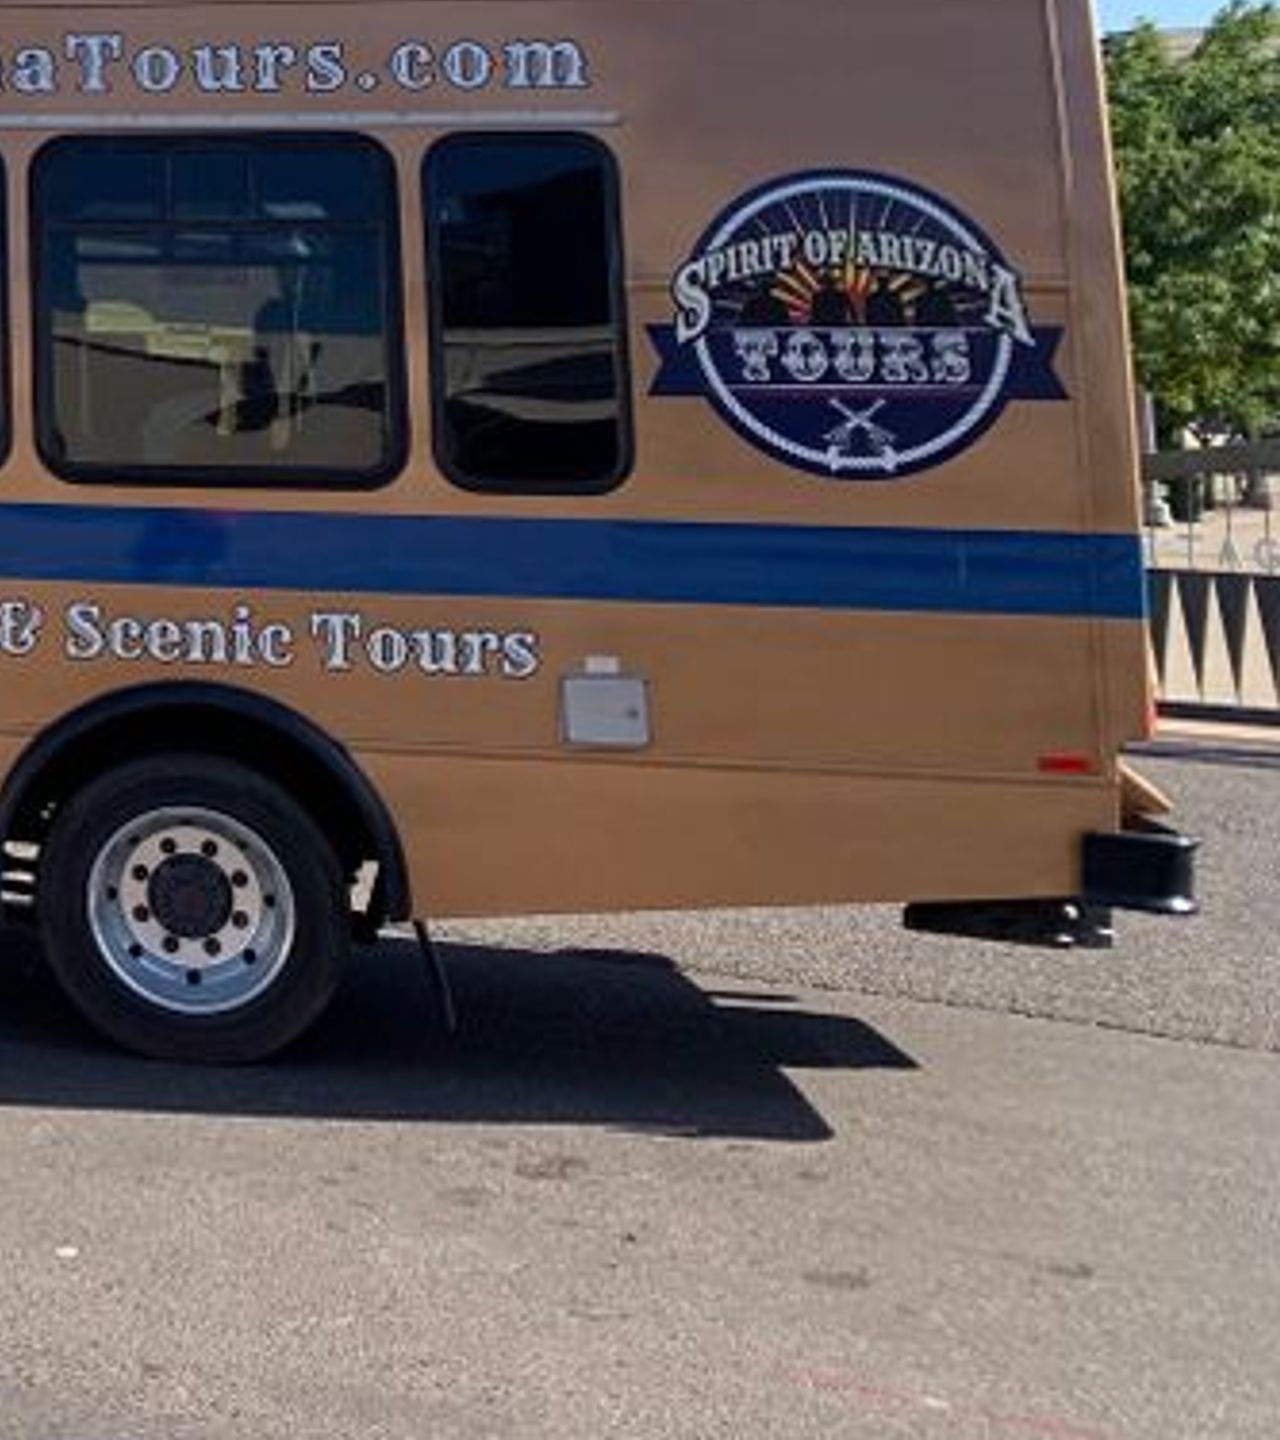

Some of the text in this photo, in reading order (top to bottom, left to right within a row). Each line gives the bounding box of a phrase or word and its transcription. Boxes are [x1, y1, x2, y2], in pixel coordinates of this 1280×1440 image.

[674, 229, 1035, 346] SPIRIT OF ARIZONA
[734, 329, 972, 383] TOURS
[65, 604, 293, 667] Scenic
[311, 613, 541, 677] Tours
